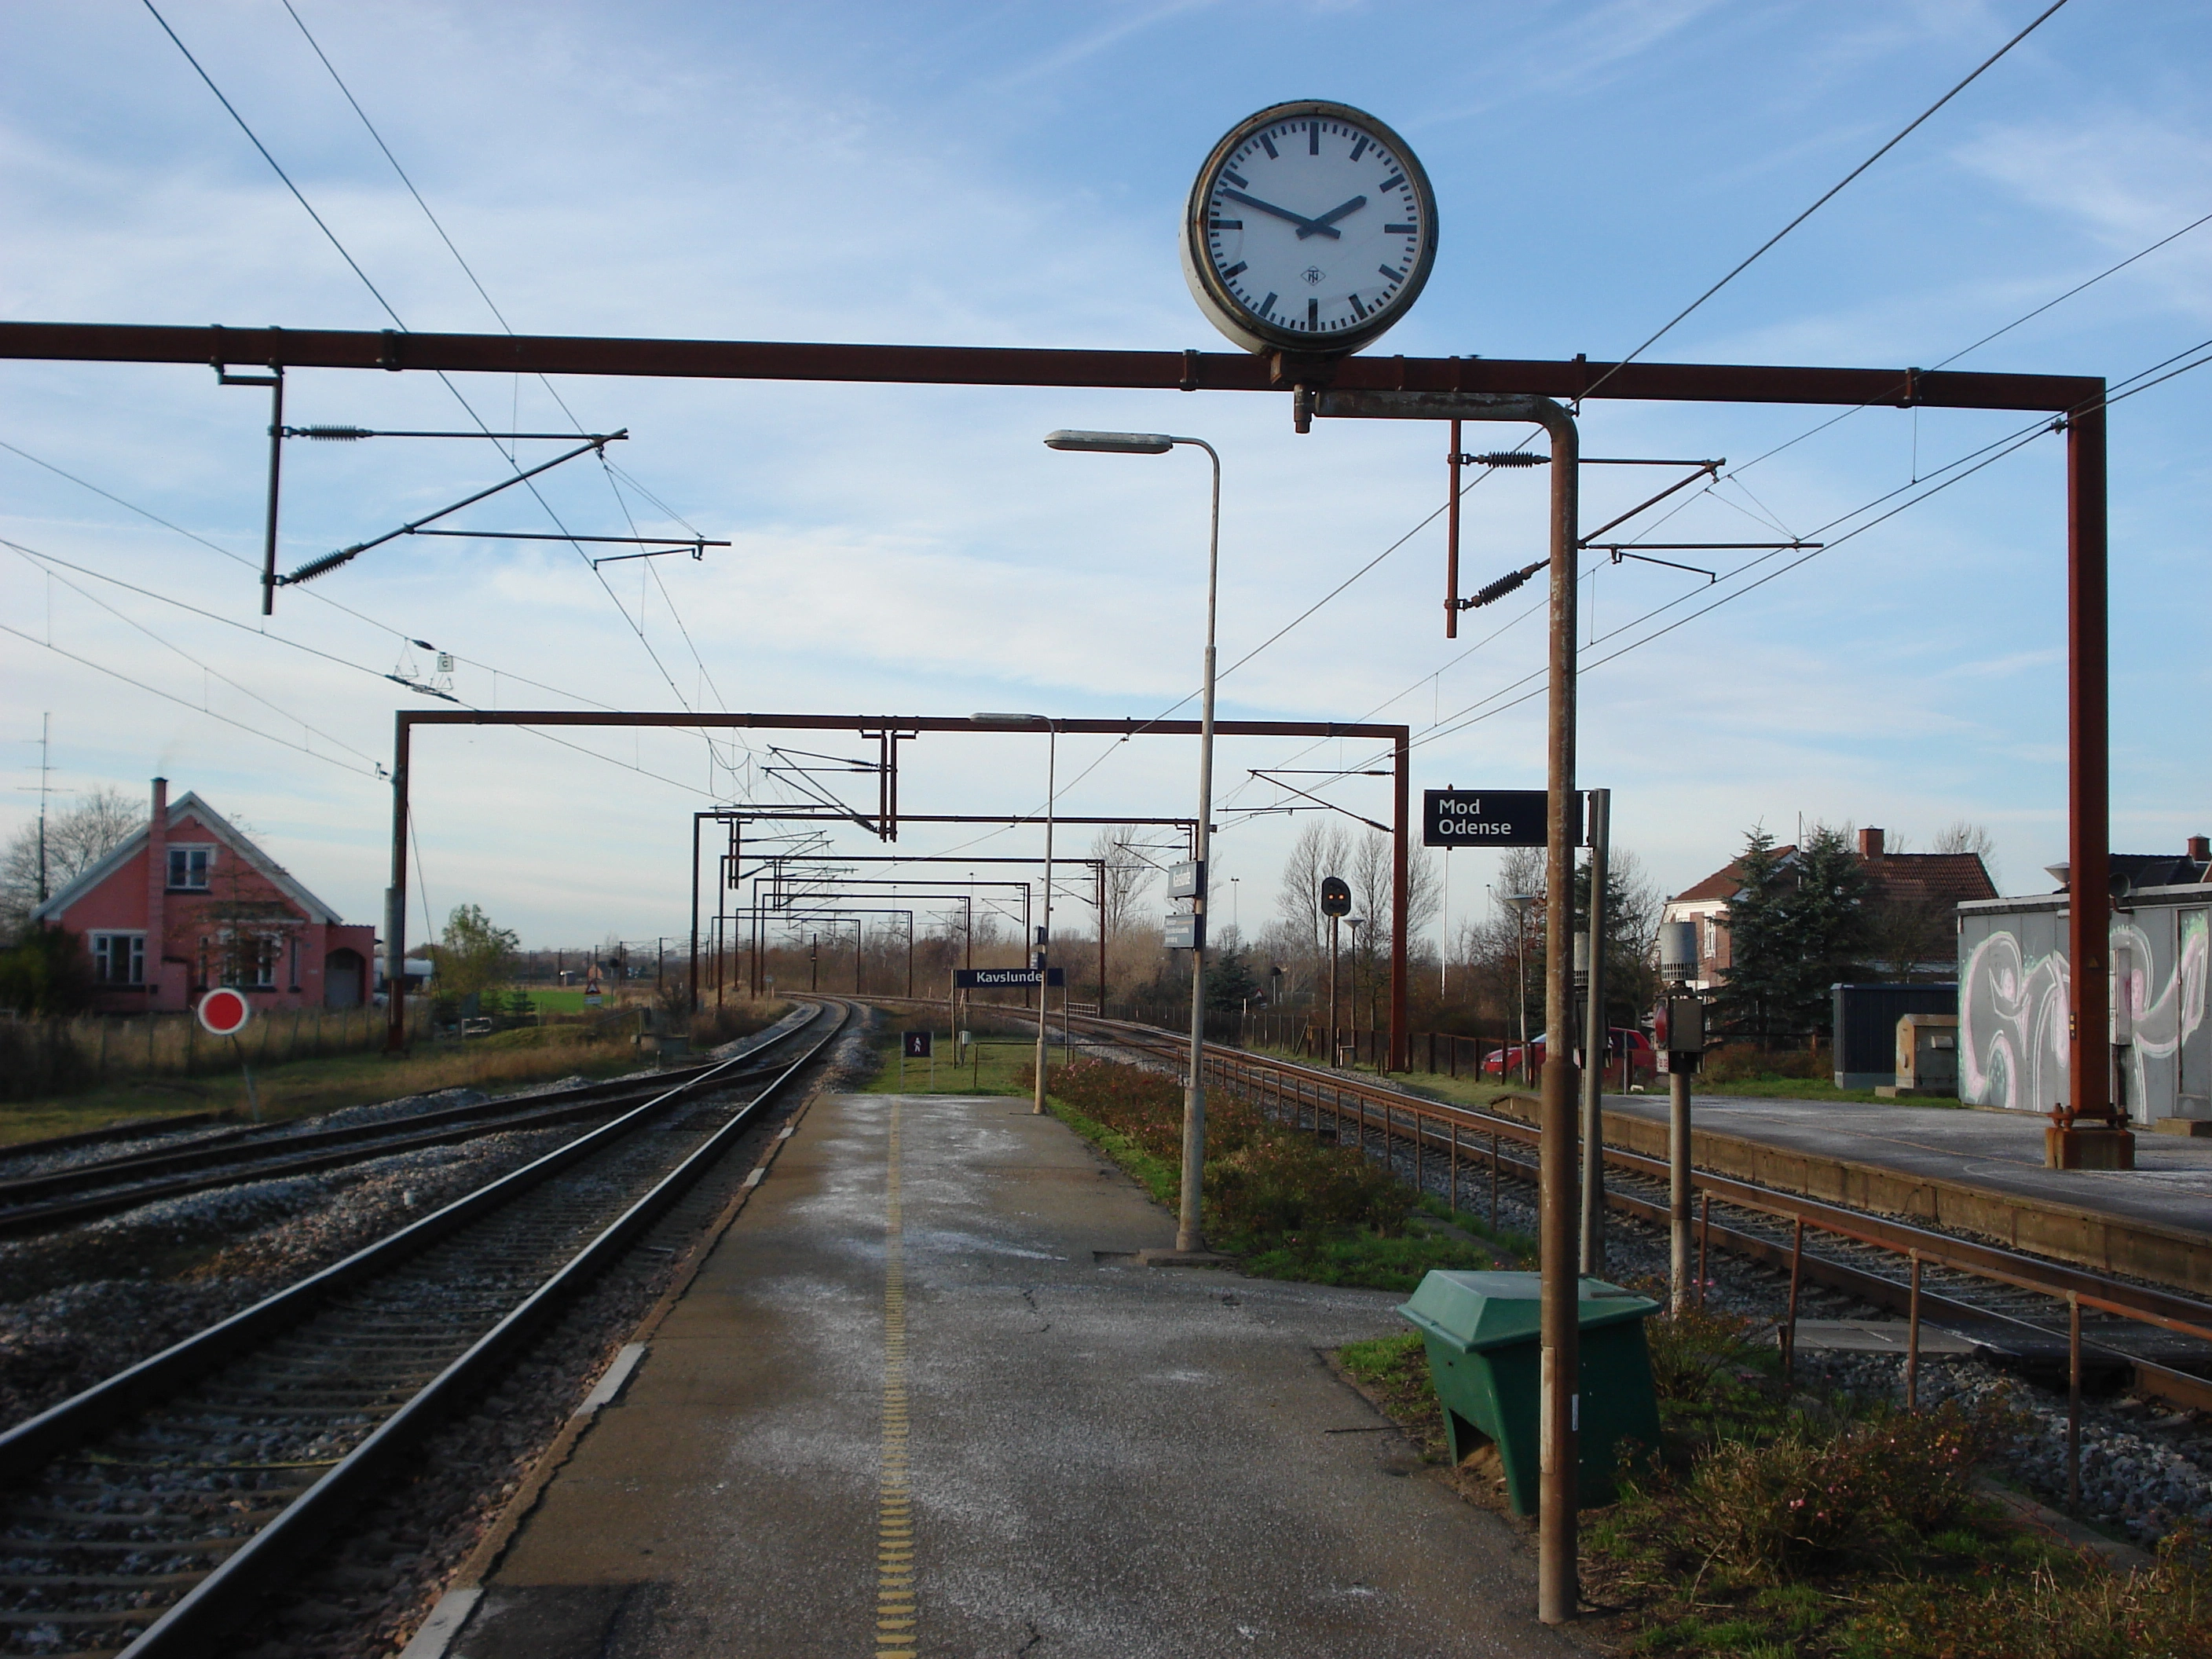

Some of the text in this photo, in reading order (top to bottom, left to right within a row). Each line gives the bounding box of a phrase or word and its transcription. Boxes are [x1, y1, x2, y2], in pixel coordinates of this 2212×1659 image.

[1438, 798, 1481, 815] Mod
[1438, 819, 1512, 835] Odense
[976, 970, 1042, 983] Kavslunde
